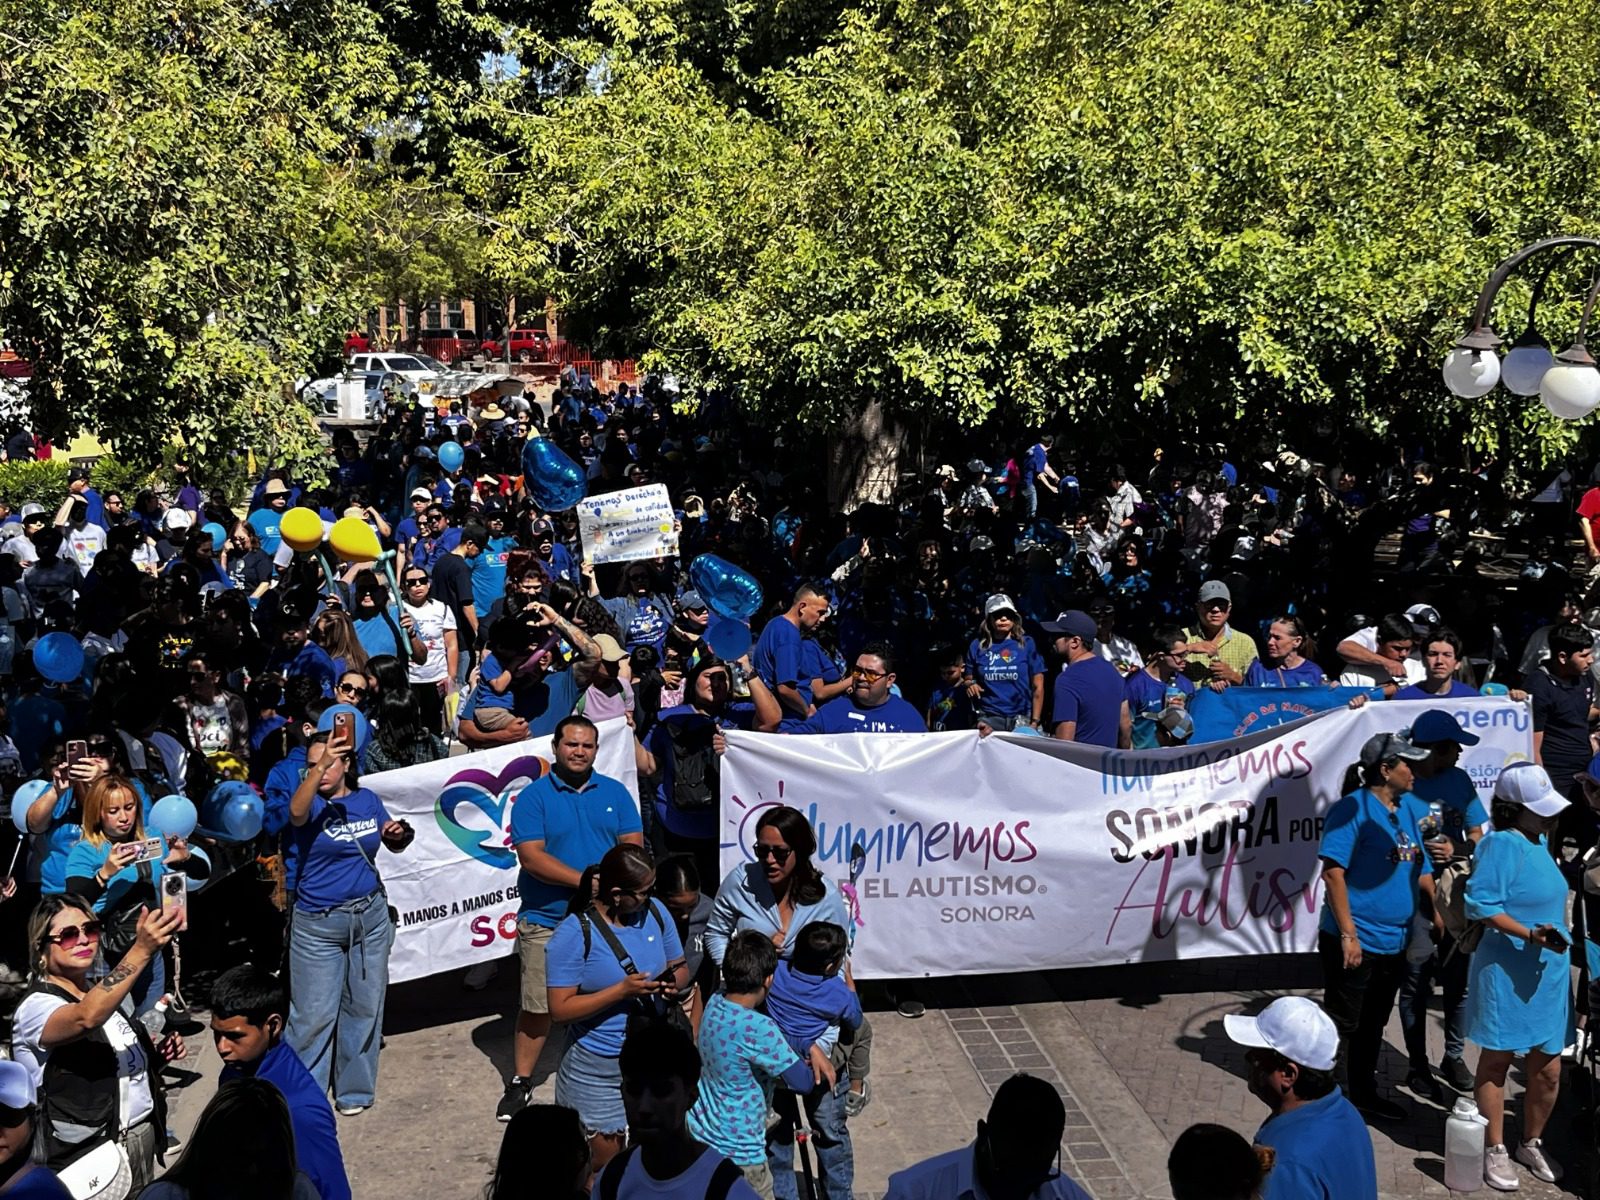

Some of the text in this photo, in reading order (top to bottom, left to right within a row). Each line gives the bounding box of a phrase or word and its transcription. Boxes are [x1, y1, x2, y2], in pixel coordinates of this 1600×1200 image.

[584, 497, 621, 509] Tenemos
[983, 672, 1019, 681] AUTISMO
[871, 721, 887, 733] I'M
[1106, 797, 1280, 863] SONORA
[864, 878, 898, 899] EL
[403, 904, 447, 927] MANOS
[452, 902, 460, 915] A
[463, 889, 503, 912] MANOS
[940, 905, 1036, 924] SONORA
